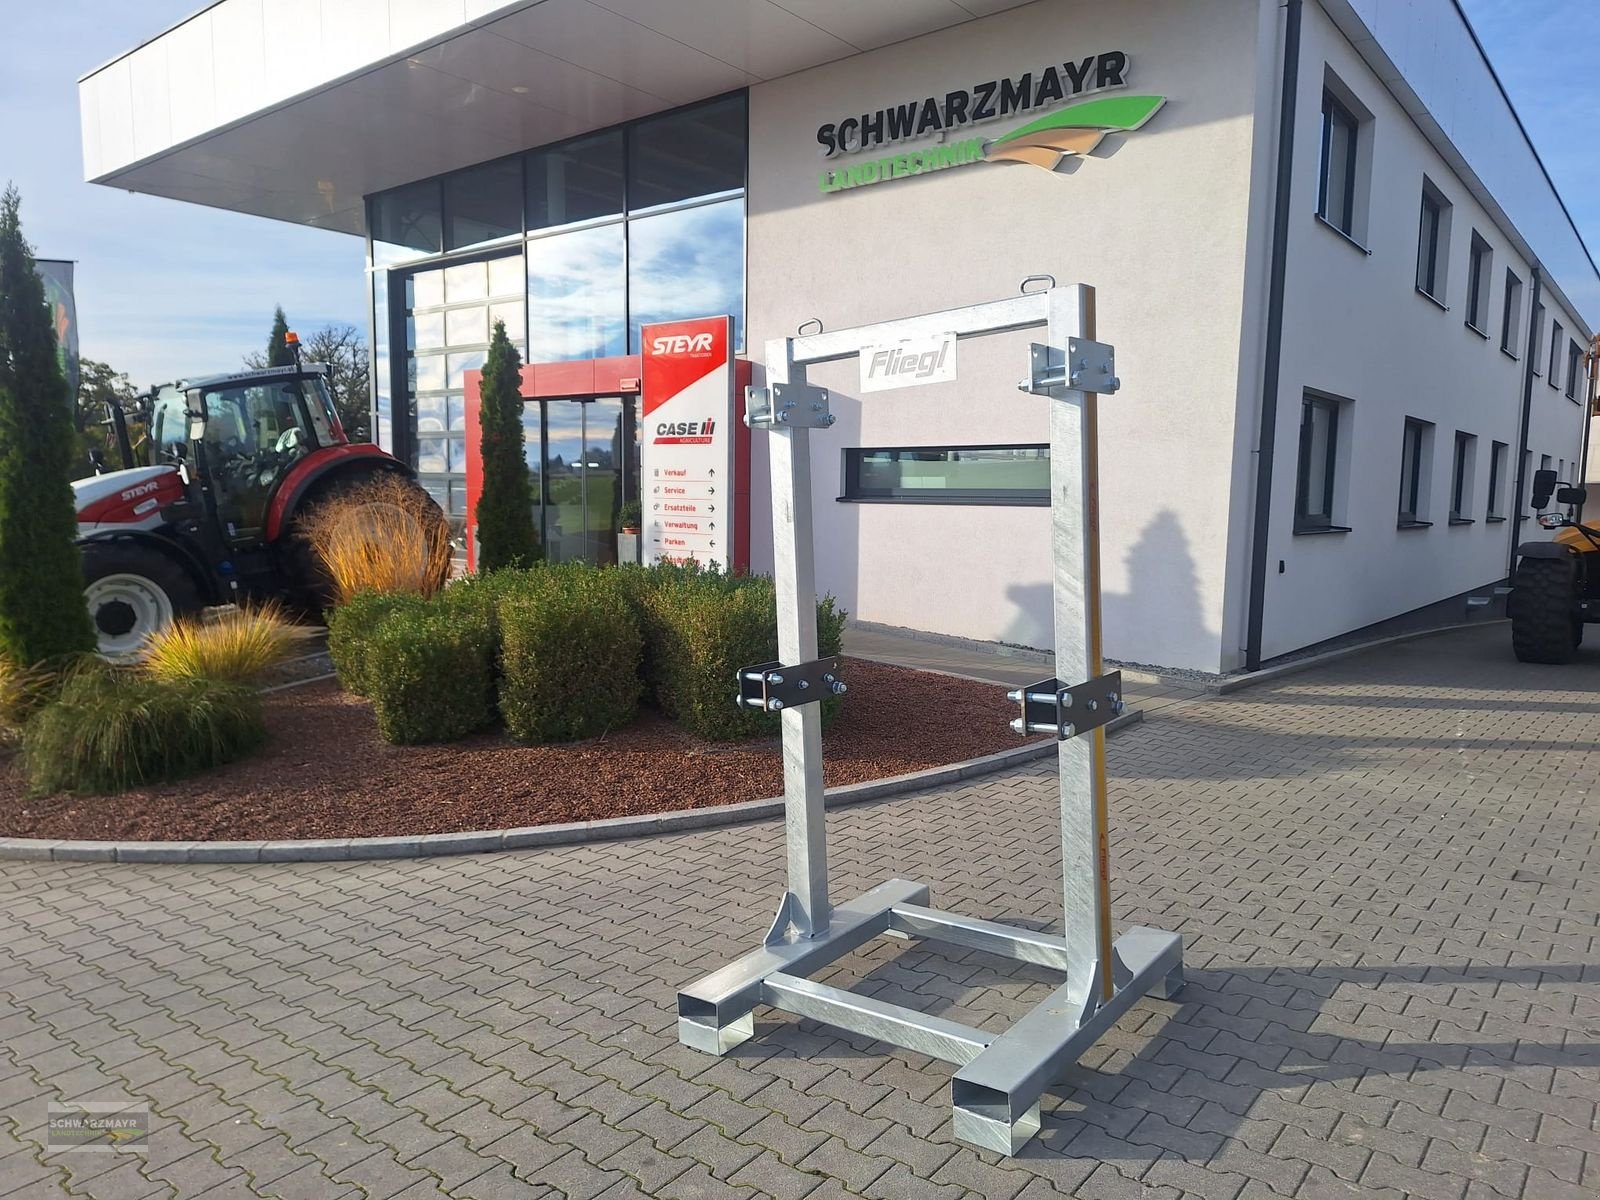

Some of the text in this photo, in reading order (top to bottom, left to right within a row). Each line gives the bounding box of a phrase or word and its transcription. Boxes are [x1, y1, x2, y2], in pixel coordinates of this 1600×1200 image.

[816, 50, 1128, 158] SCHWARZMAYR
[818, 136, 984, 193] LANDTECHNIK
[652, 333, 713, 355] STEYR
[868, 340, 950, 379] Fliegl
[656, 422, 697, 435] CASE
[121, 481, 159, 500] STEYR
[664, 486, 686, 495] Service
[664, 504, 697, 512] Ersatzteile
[664, 520, 698, 531] Verwaltung
[664, 537, 686, 546] Parken
